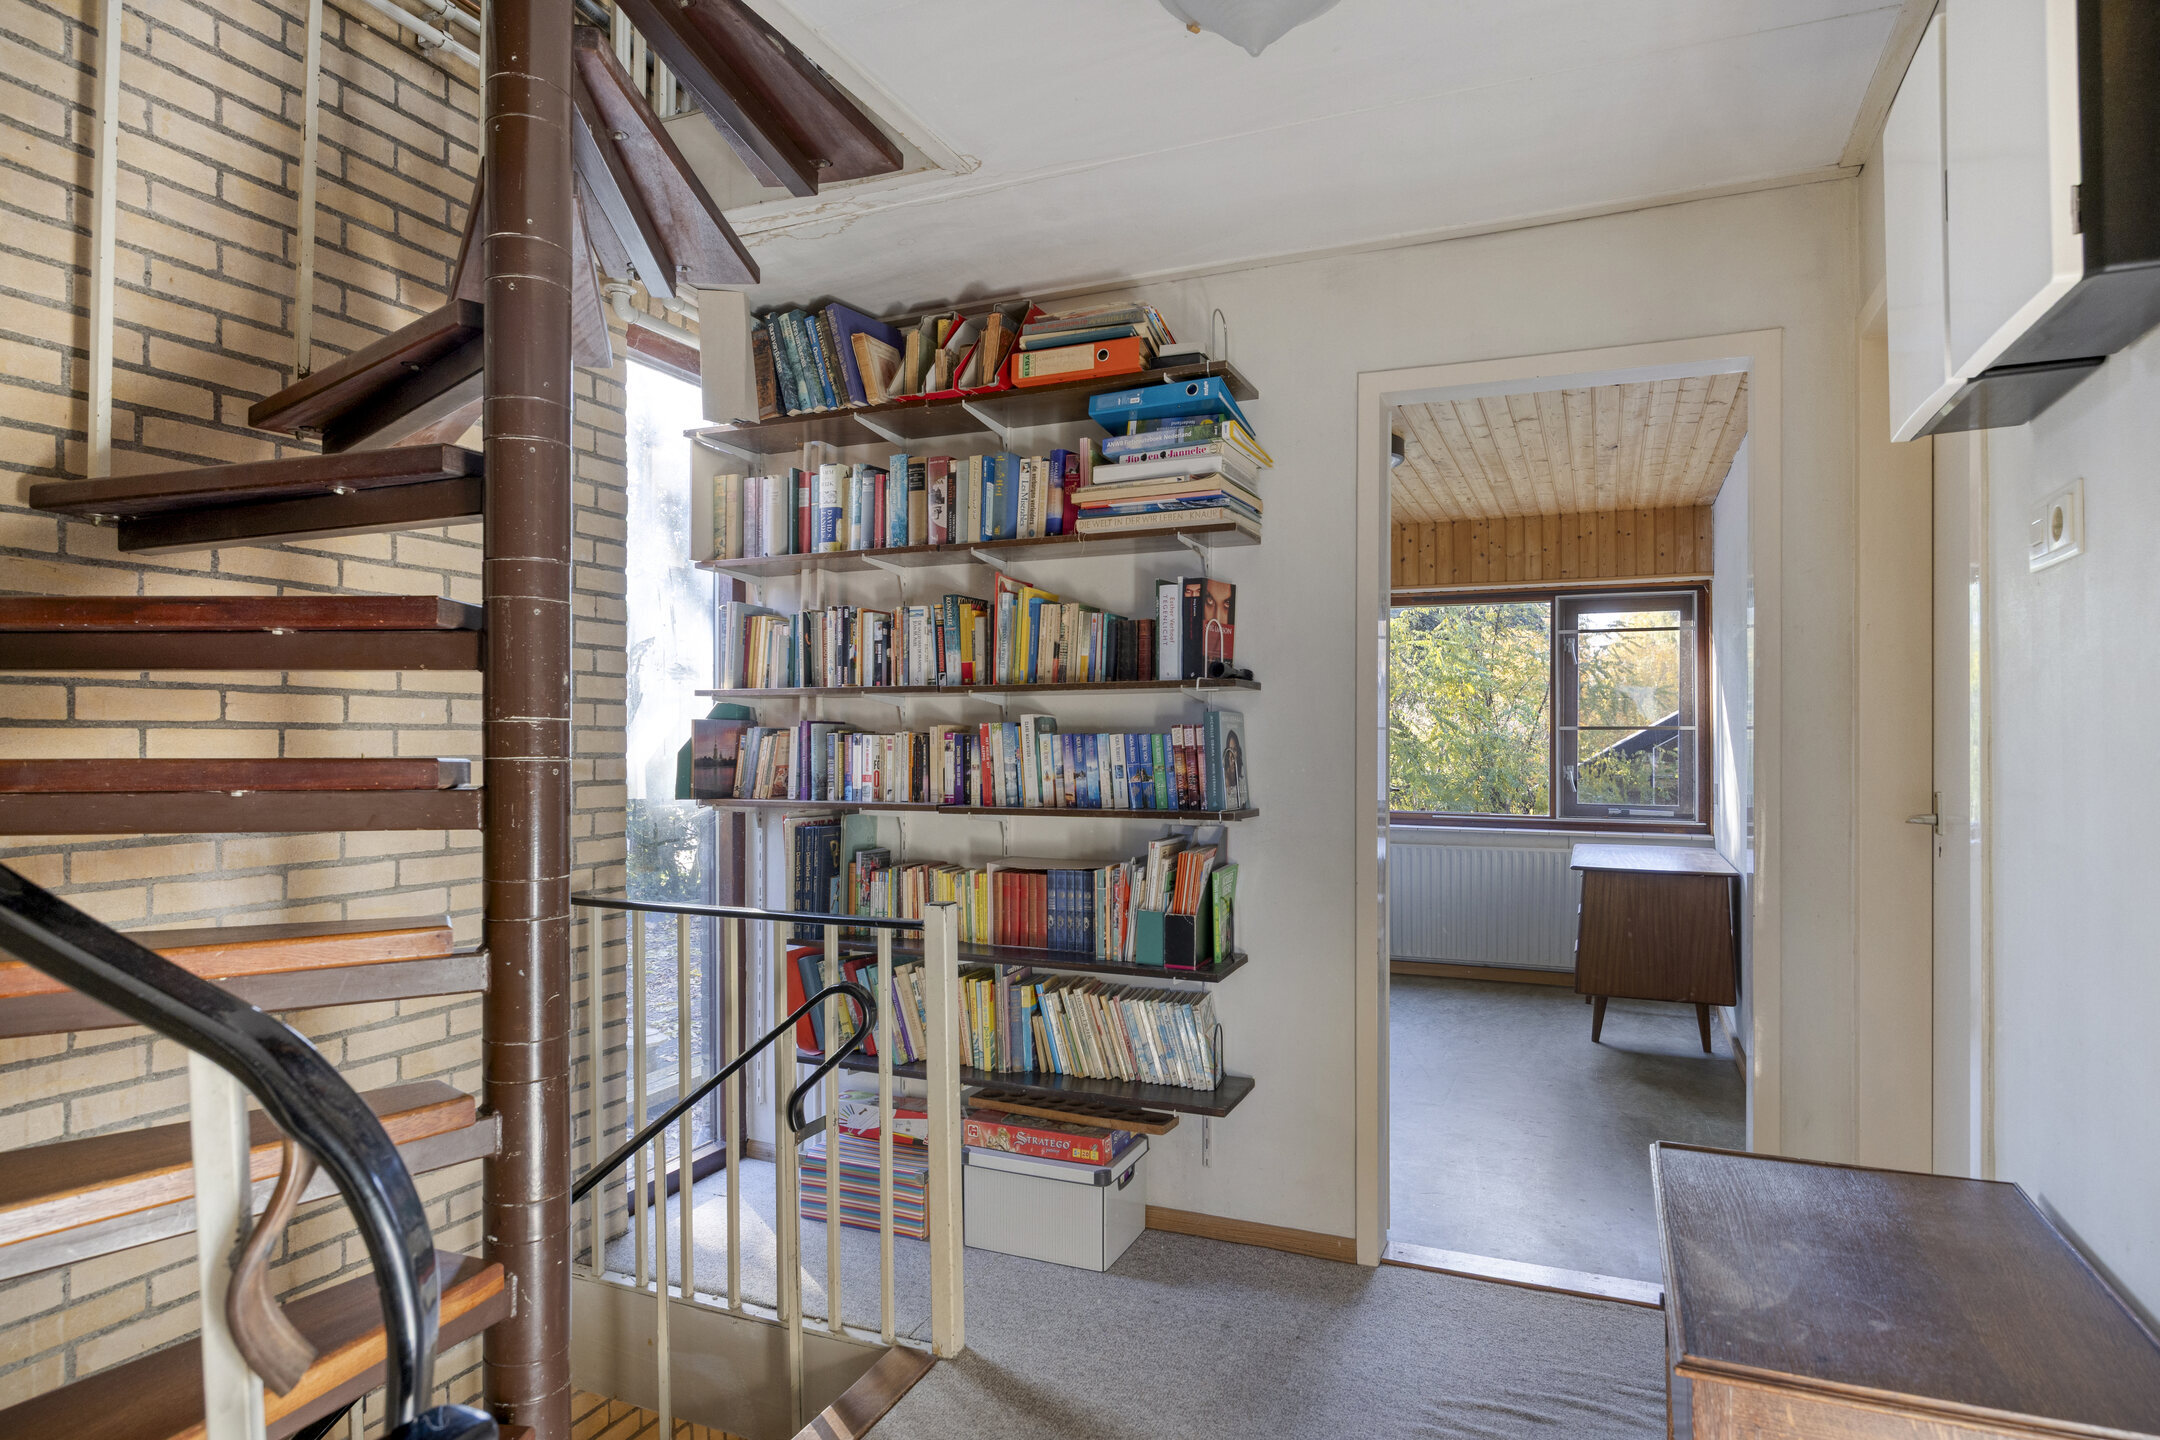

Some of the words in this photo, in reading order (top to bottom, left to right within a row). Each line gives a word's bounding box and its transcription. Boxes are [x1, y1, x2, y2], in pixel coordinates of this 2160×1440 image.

[1106, 440, 1124, 449] ANWB
[1163, 430, 1192, 441] Nederland
[1125, 454, 1140, 464] Jip
[1148, 453, 1160, 461] en
[1167, 446, 1207, 458] Janneke
[1021, 480, 1029, 492] Les
[1030, 473, 1038, 499] verborgen
[1029, 499, 1037, 525] verleiders
[1079, 519, 1091, 530] DIE
[1092, 518, 1112, 528] WELT
[1114, 517, 1123, 526] IN
[1125, 516, 1141, 525] DER
[1142, 515, 1158, 524] WIR
[1159, 513, 1183, 523] LEBEN
[1189, 510, 1218, 520] KNAUR
[1013, 1131, 1070, 1150] STRATEGO
